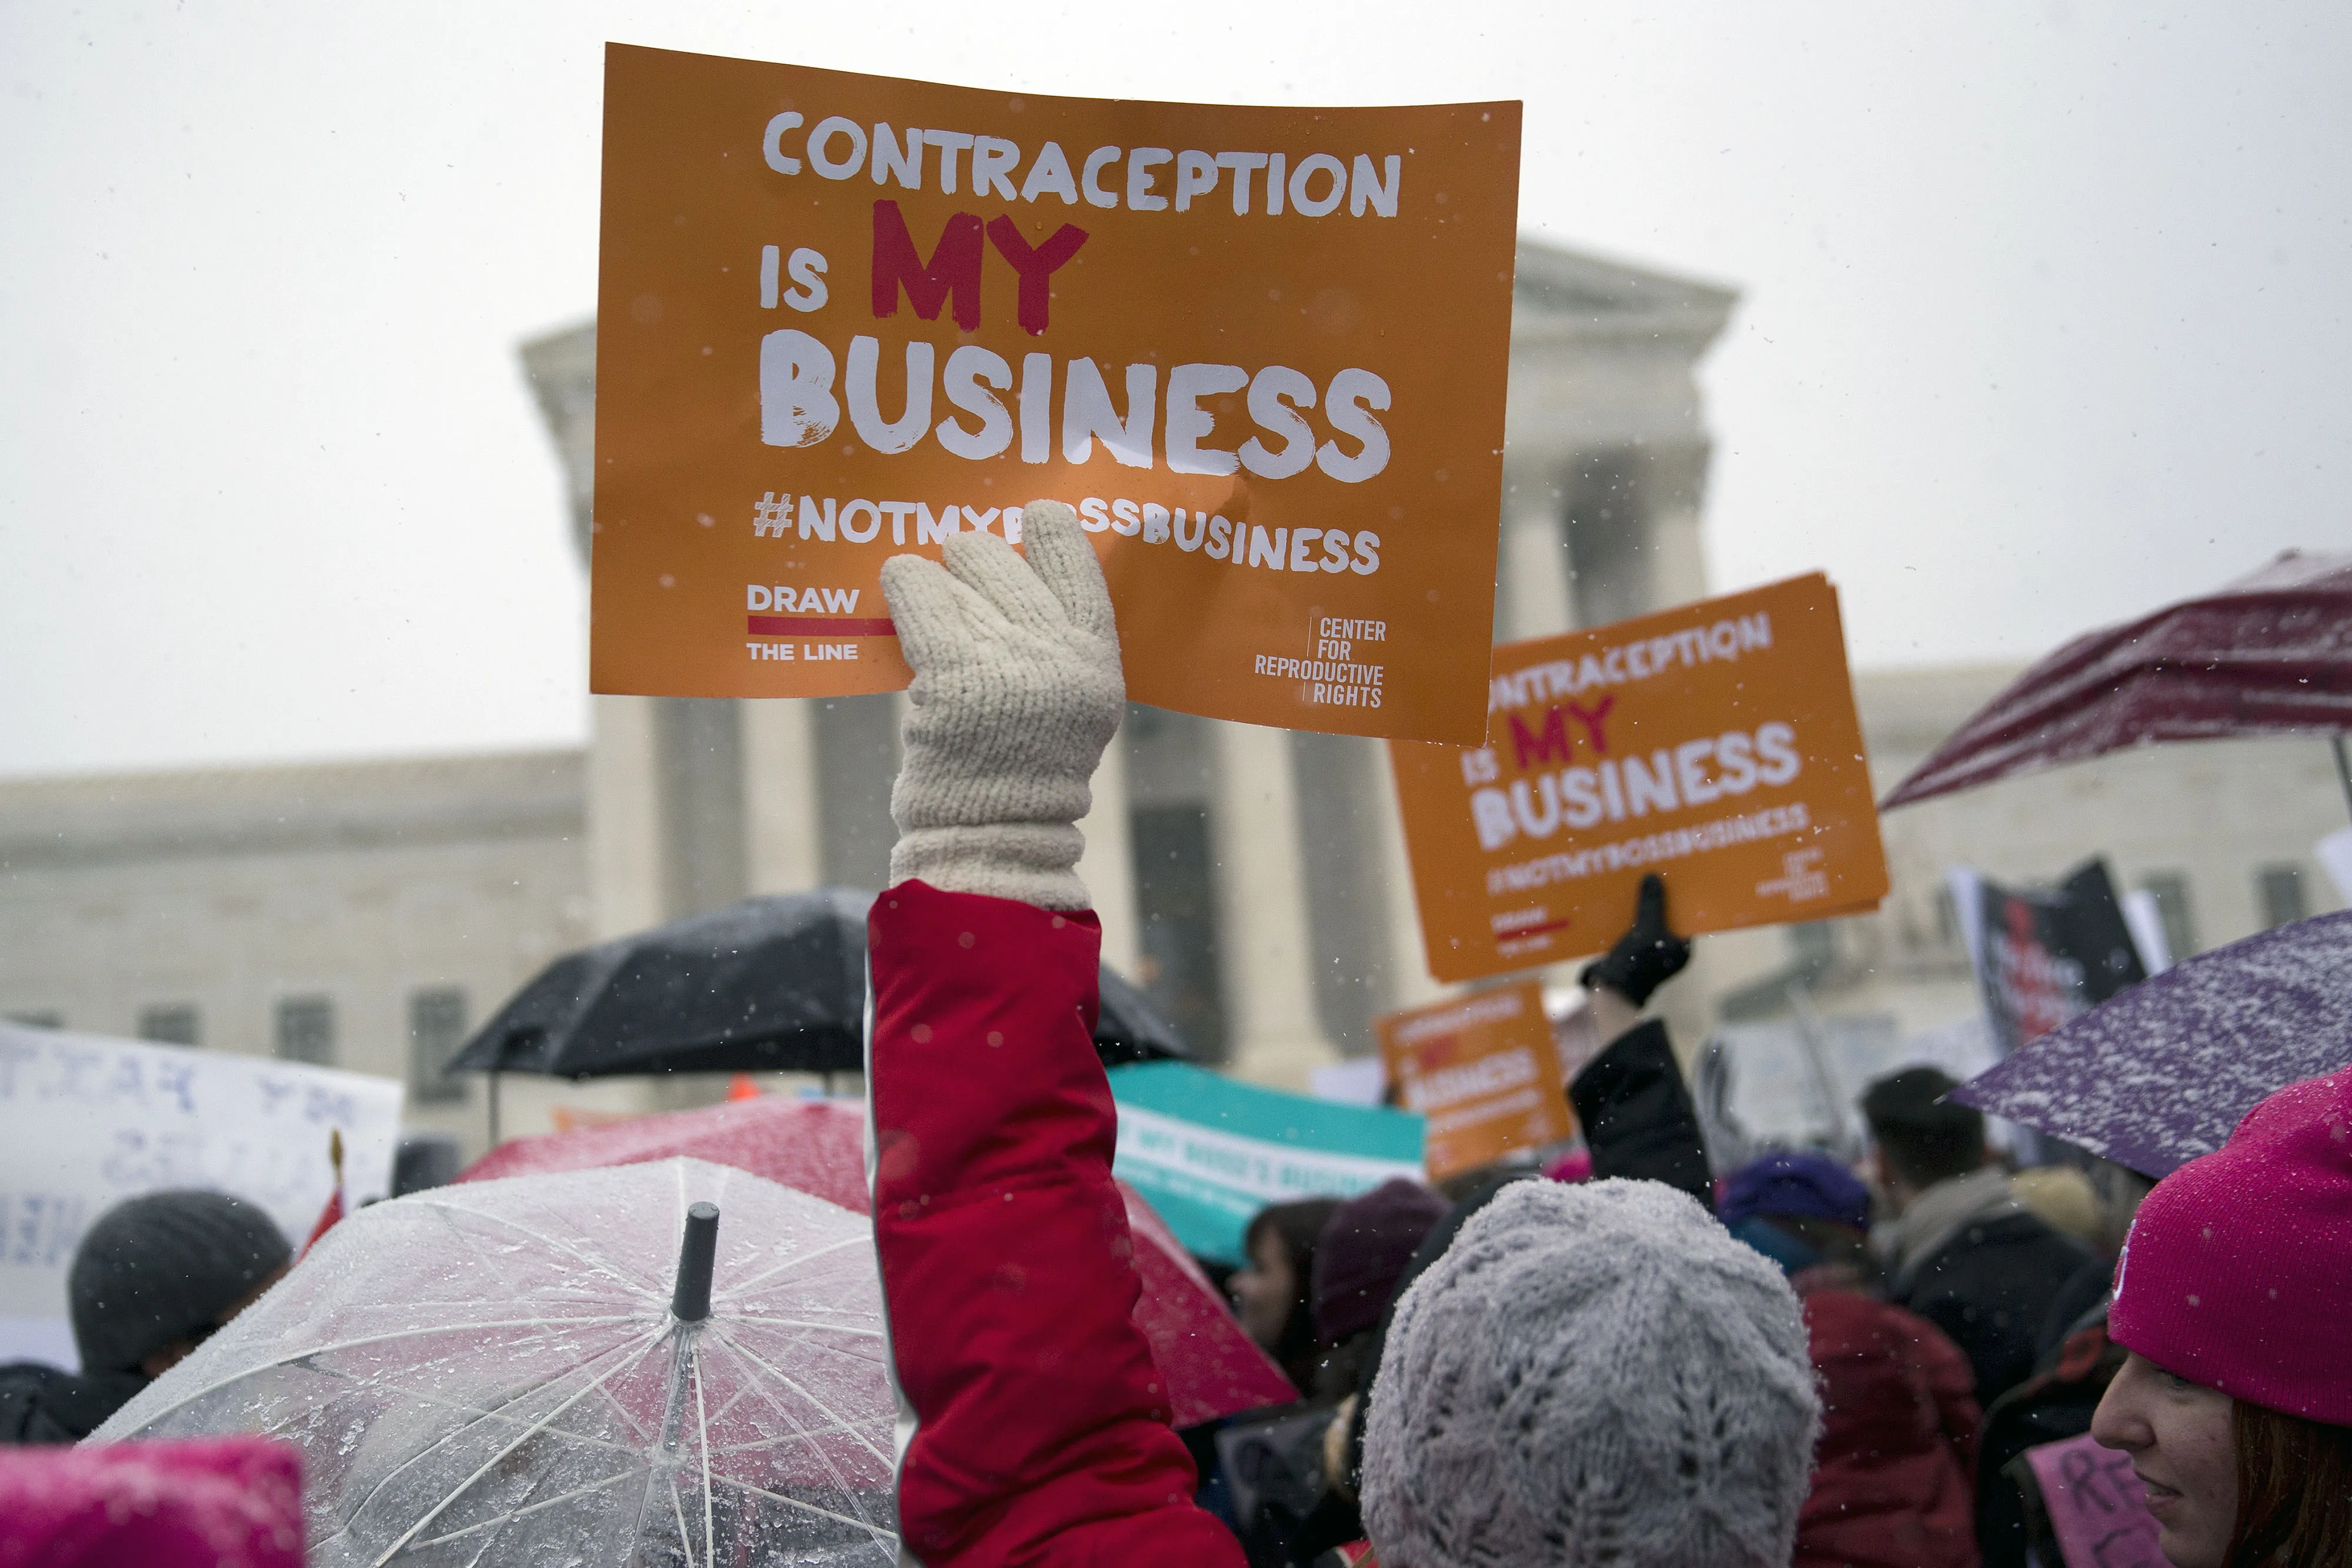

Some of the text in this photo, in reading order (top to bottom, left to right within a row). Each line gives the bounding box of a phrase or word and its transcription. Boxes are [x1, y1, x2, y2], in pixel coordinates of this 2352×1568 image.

[763, 111, 1401, 217] CONTRACEPTION
[760, 200, 1089, 336] IS MY
[760, 329, 1391, 483] BUSINESS
[754, 492, 1380, 575] #NOTMYBSSBUSINESS
[747, 585, 859, 614] DRAW
[747, 643, 858, 660] THE LINE
[1318, 640, 1351, 661] FOR
[1320, 617, 1387, 641] CENTER
[1255, 654, 1384, 686] REPRODUCTIVE
[1313, 683, 1382, 708] RIGHTS
[1507, 693, 1616, 771] MY
[1471, 721, 1802, 852] BUSINESS
